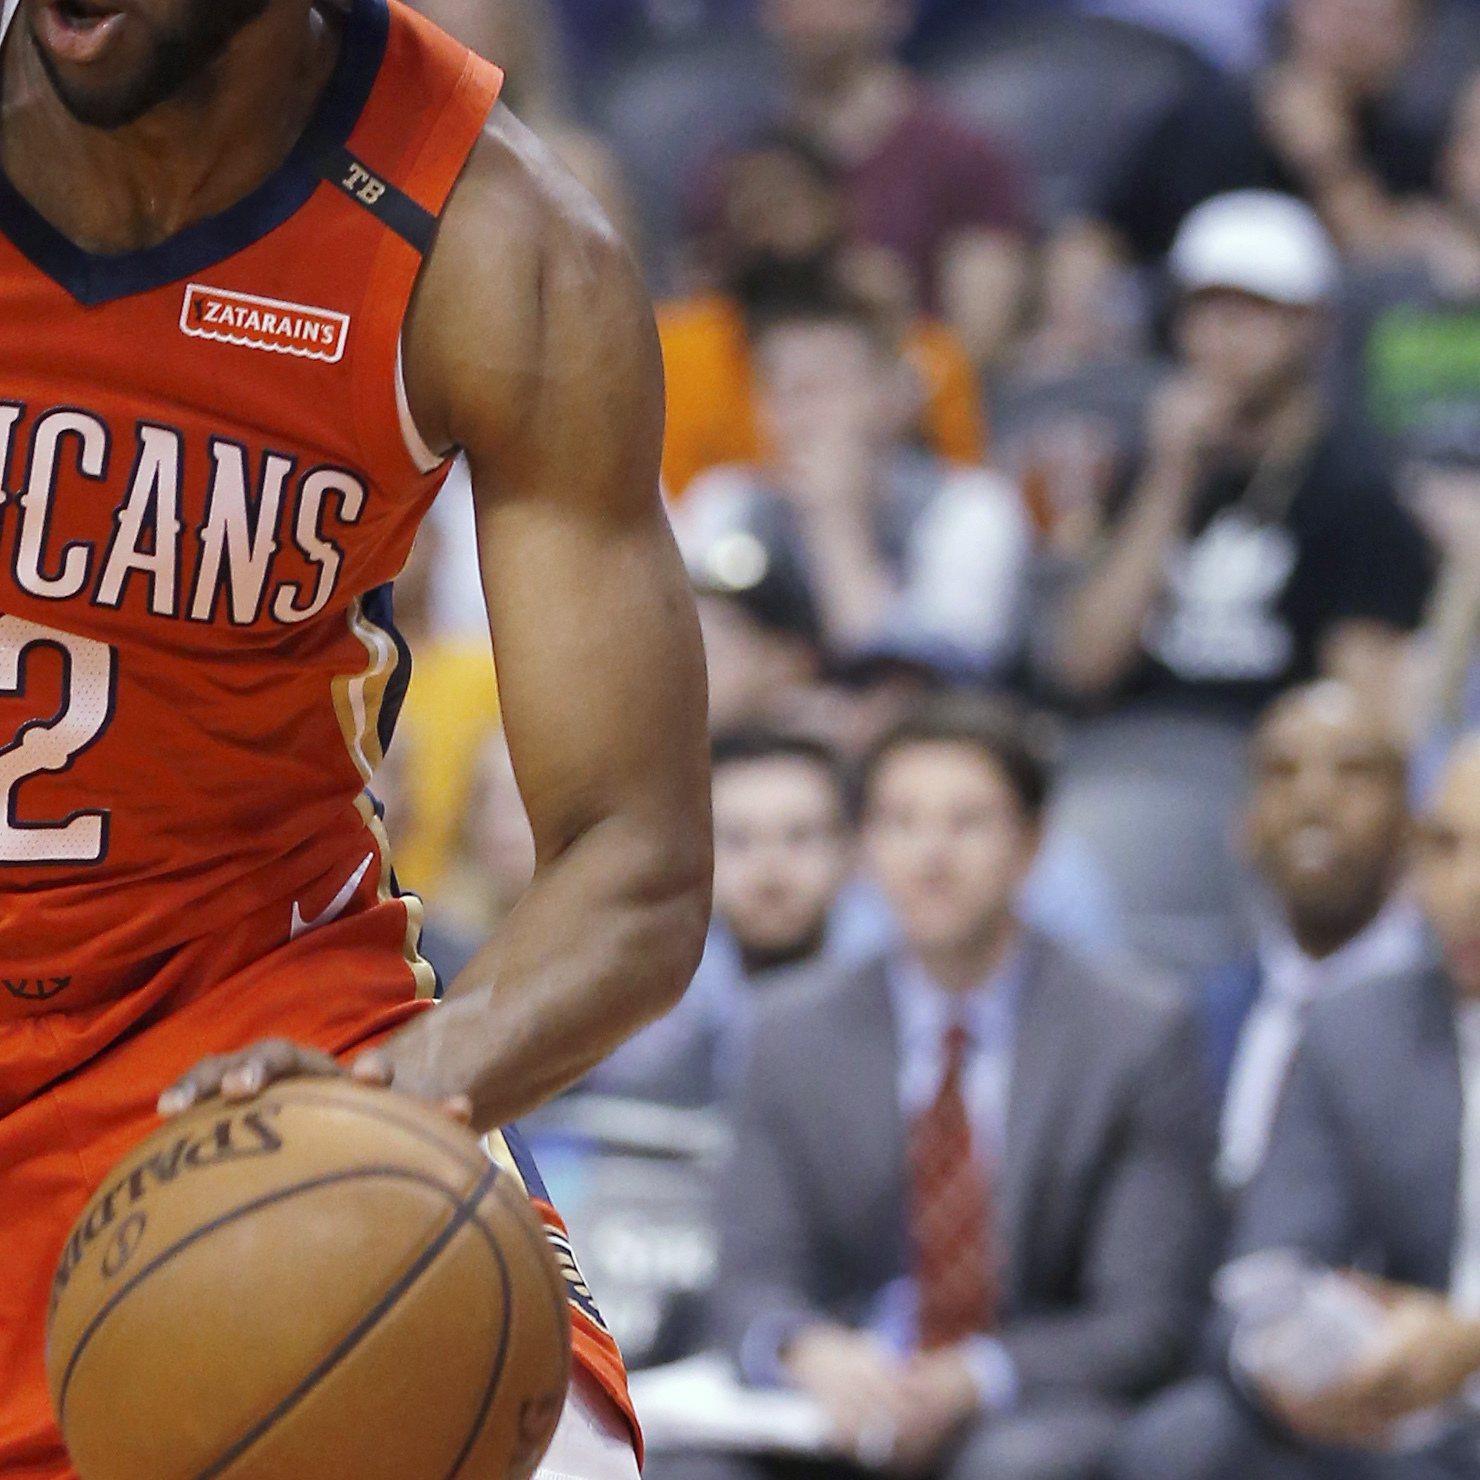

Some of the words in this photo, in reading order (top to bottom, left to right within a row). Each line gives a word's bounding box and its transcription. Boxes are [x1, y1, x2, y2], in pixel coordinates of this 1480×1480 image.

[341, 162, 386, 205] TB
[203, 300, 335, 345] ZATARAIN'S
[50, 1102, 283, 1317] SPALDIN
